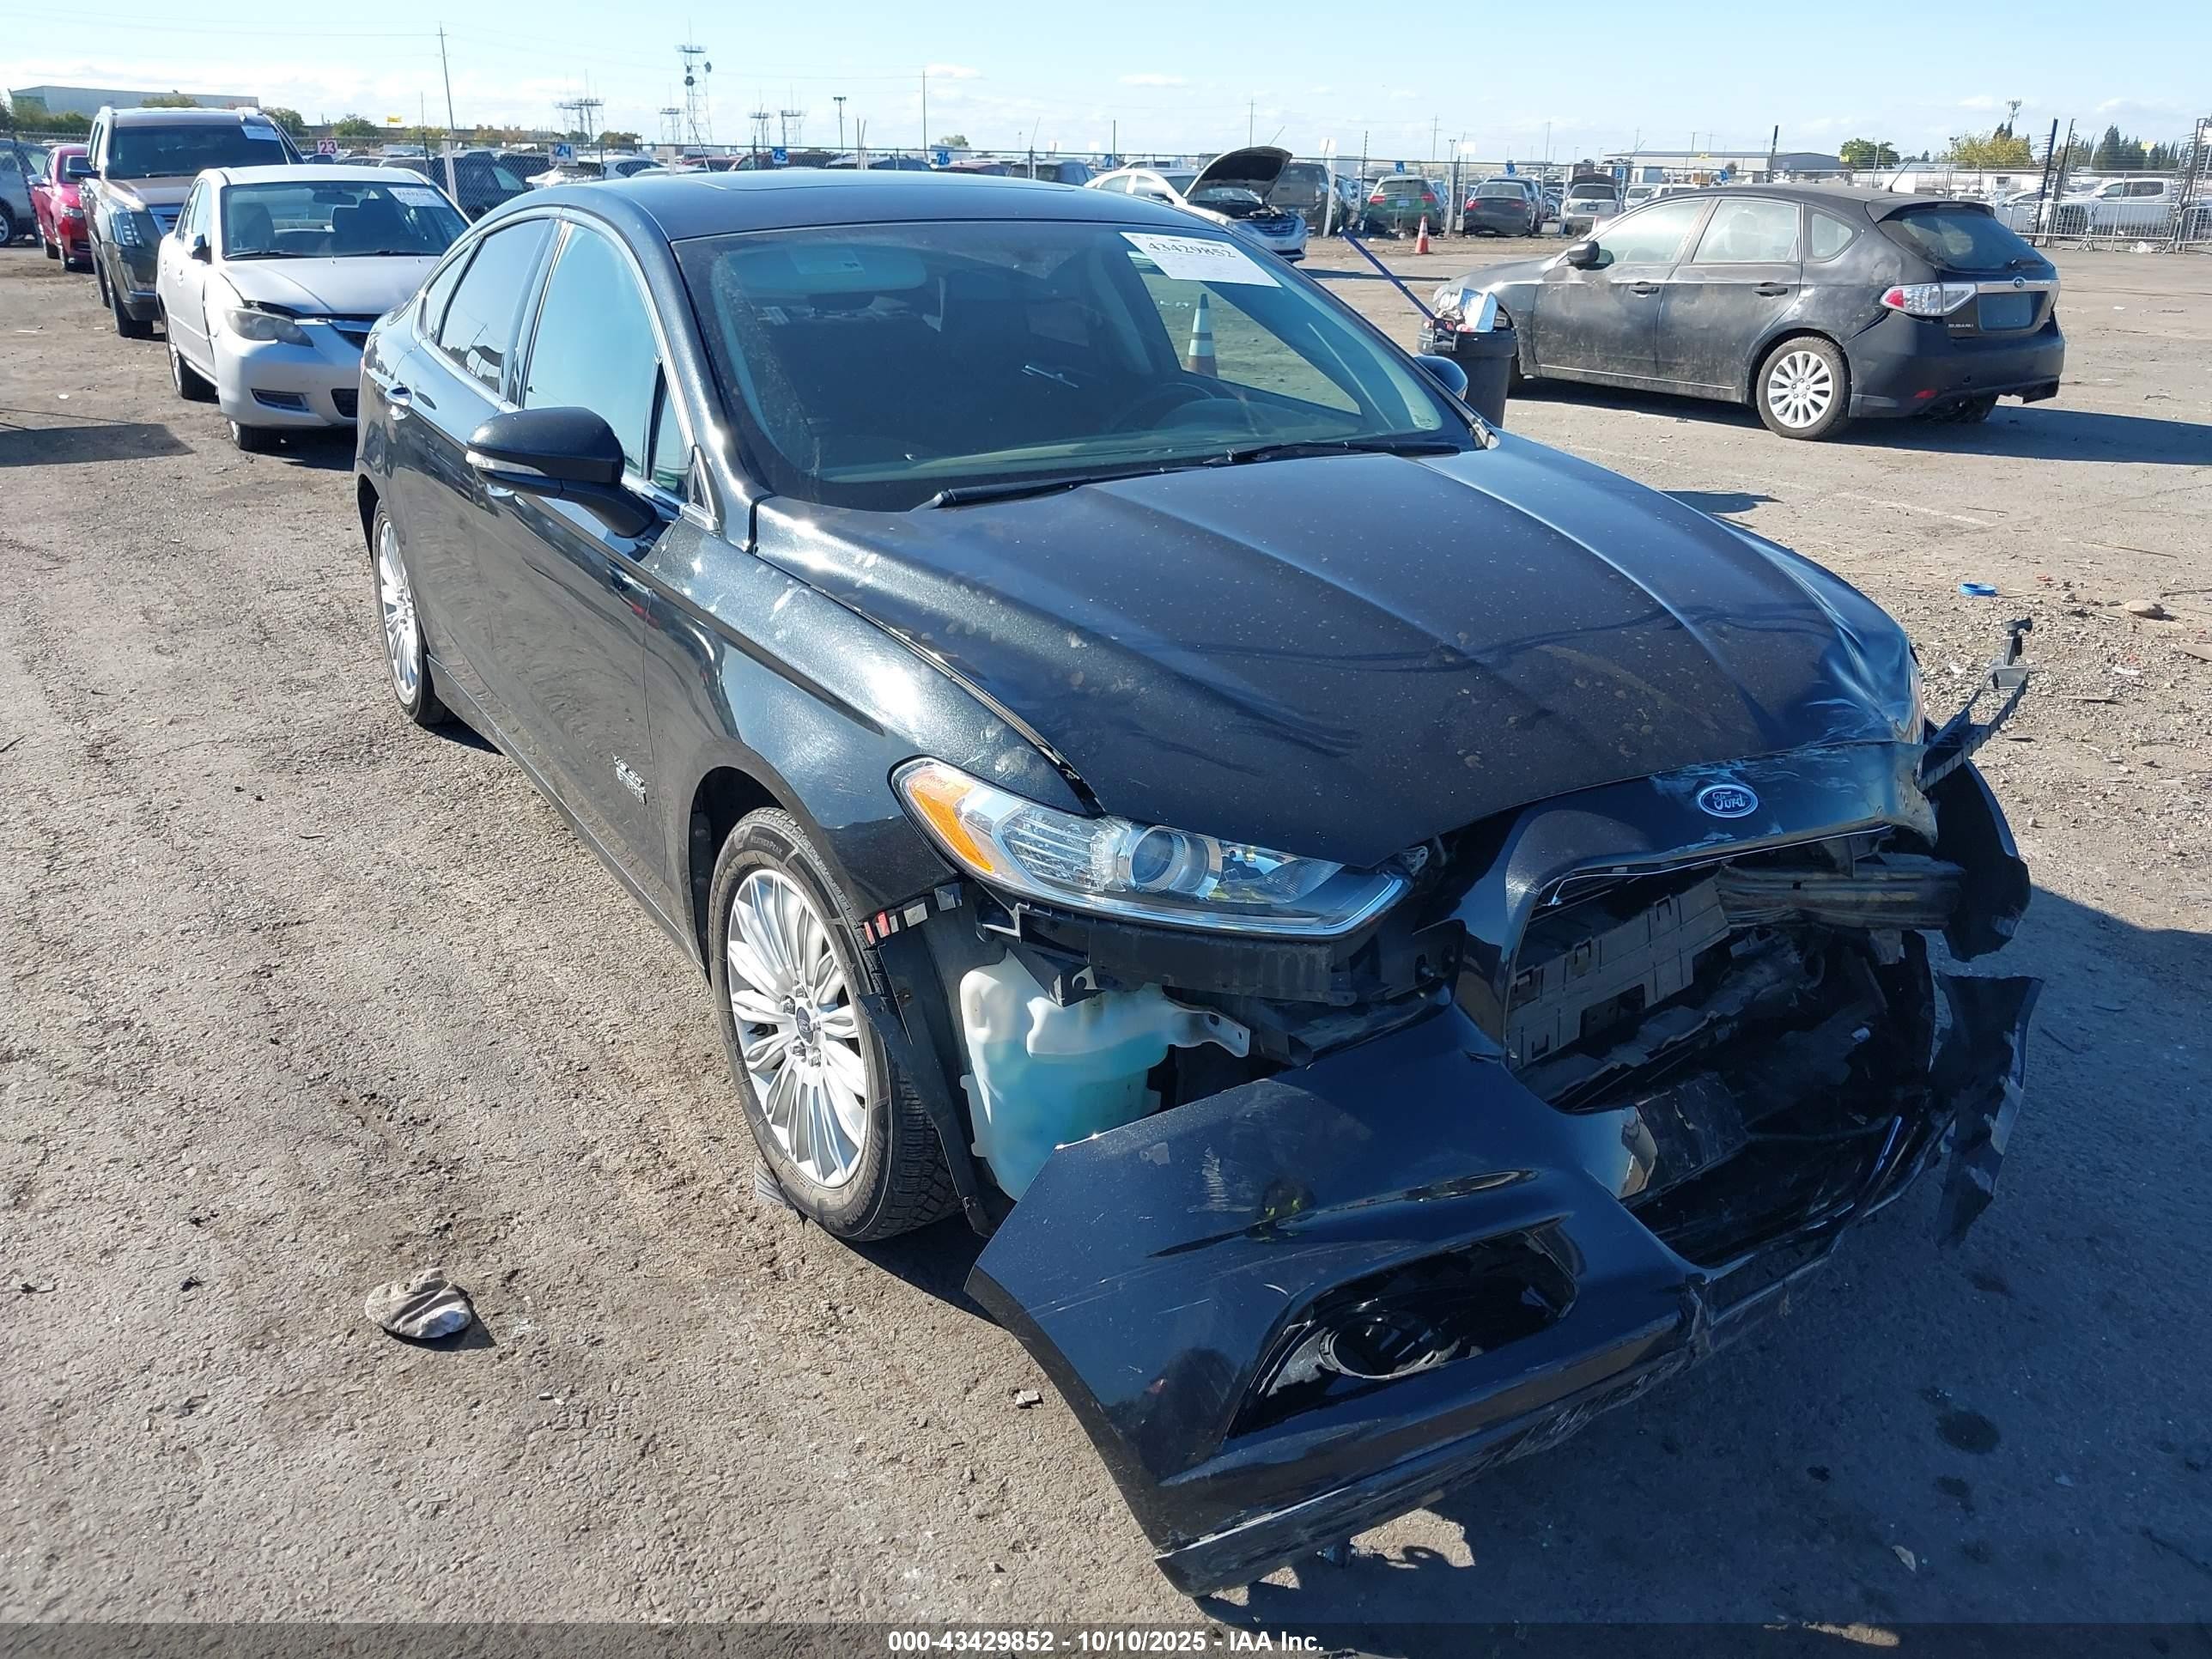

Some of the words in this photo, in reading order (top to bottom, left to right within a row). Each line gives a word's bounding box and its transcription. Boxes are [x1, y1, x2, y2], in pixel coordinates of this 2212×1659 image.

[319, 141, 337, 155] 23
[556, 144, 571, 159] 24
[773, 148, 787, 161] 25
[937, 151, 950, 165] 26
[1148, 241, 1237, 258] 43429852
[1711, 790, 1746, 811] Ford
